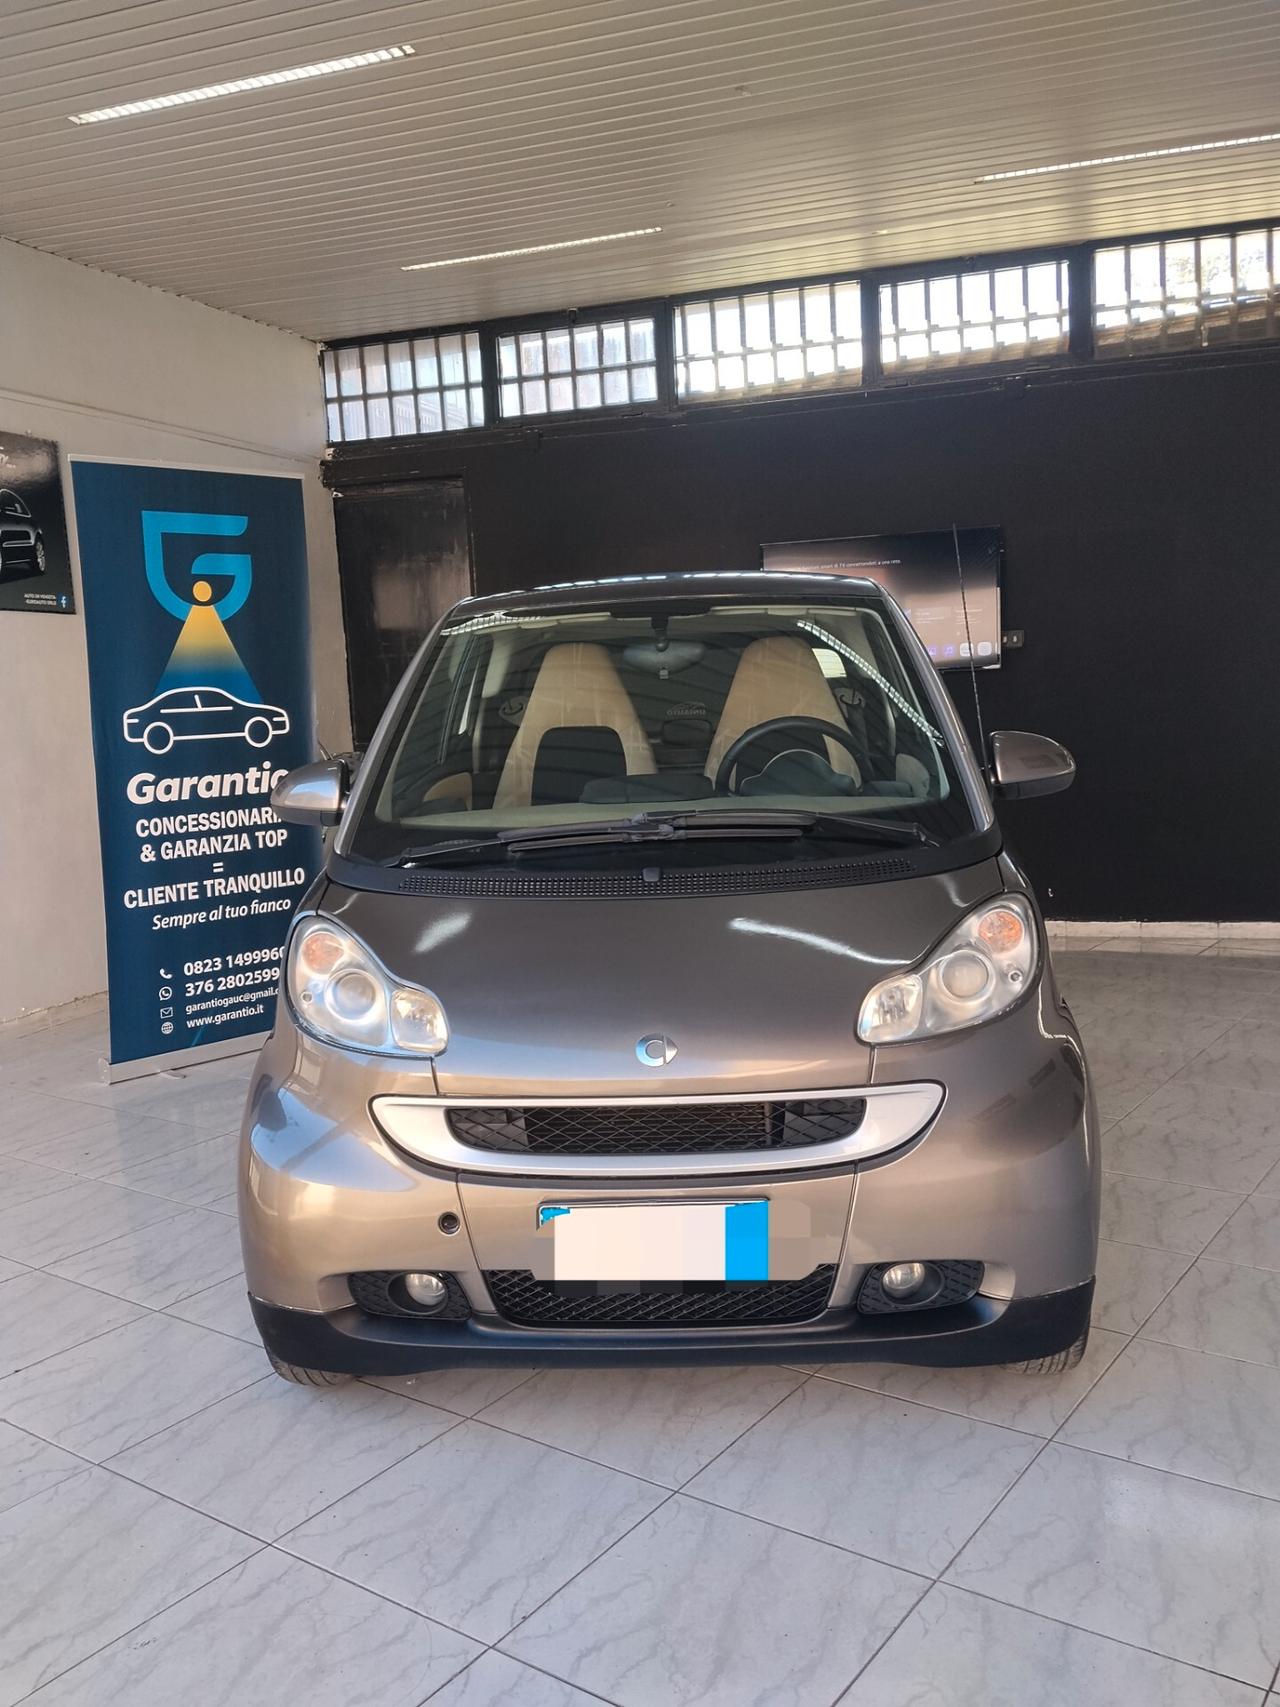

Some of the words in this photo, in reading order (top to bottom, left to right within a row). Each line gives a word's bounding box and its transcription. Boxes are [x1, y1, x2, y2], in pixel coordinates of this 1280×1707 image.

[135, 806, 282, 838] CONCESSIONARI
[140, 844, 157, 863] &
[160, 833, 251, 860] GARANZIA
[255, 829, 288, 849] TOP
[123, 882, 199, 909] CLIENTE
[203, 867, 305, 898] TRANQUILLO
[152, 911, 206, 930] Sempre
[208, 905, 222, 920] al
[225, 902, 248, 919] tuo
[250, 899, 291, 915] fianco
[183, 957, 222, 976] 0823
[185, 980, 214, 997] 376
[217, 967, 280, 991] 2802599
[186, 1004, 264, 1028] www.garantio.it
